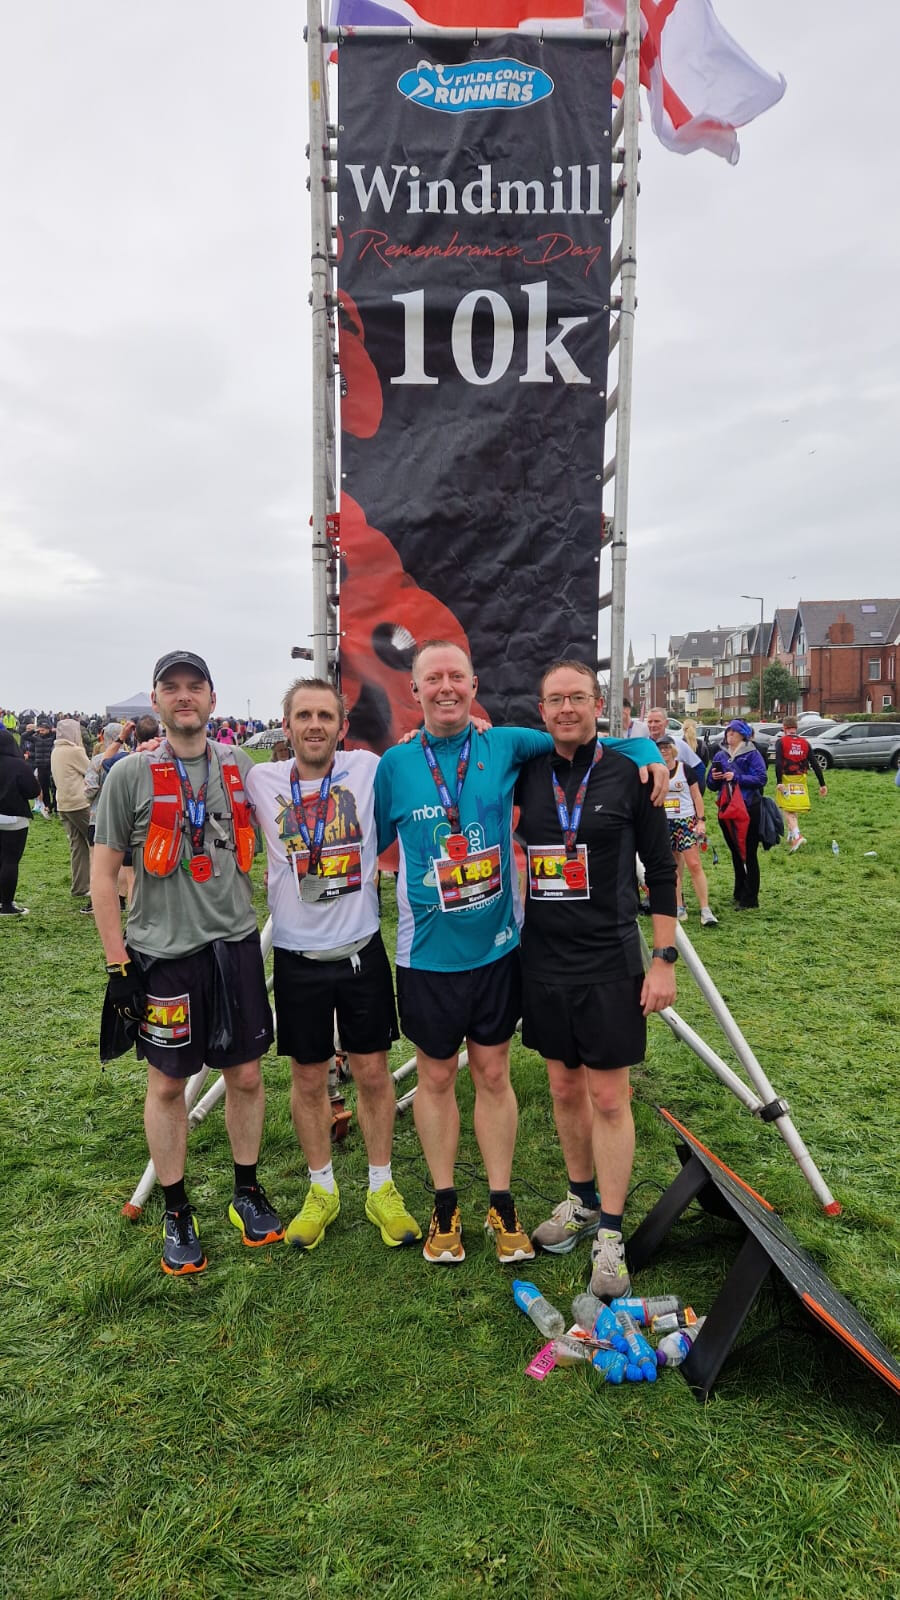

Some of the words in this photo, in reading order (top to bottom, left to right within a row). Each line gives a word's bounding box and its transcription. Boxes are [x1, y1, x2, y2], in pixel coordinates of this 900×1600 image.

[454, 70, 493, 87] FYLDE
[494, 69, 536, 82] COAST
[434, 81, 534, 105] RUNNERS
[344, 163, 604, 215] Windmill
[349, 228, 523, 269] Remembrance
[523, 232, 603, 278] Day
[390, 280, 592, 386] 10k
[468, 828, 481, 854] 202
[450, 859, 493, 885] 148
[147, 1005, 187, 1026] 214
